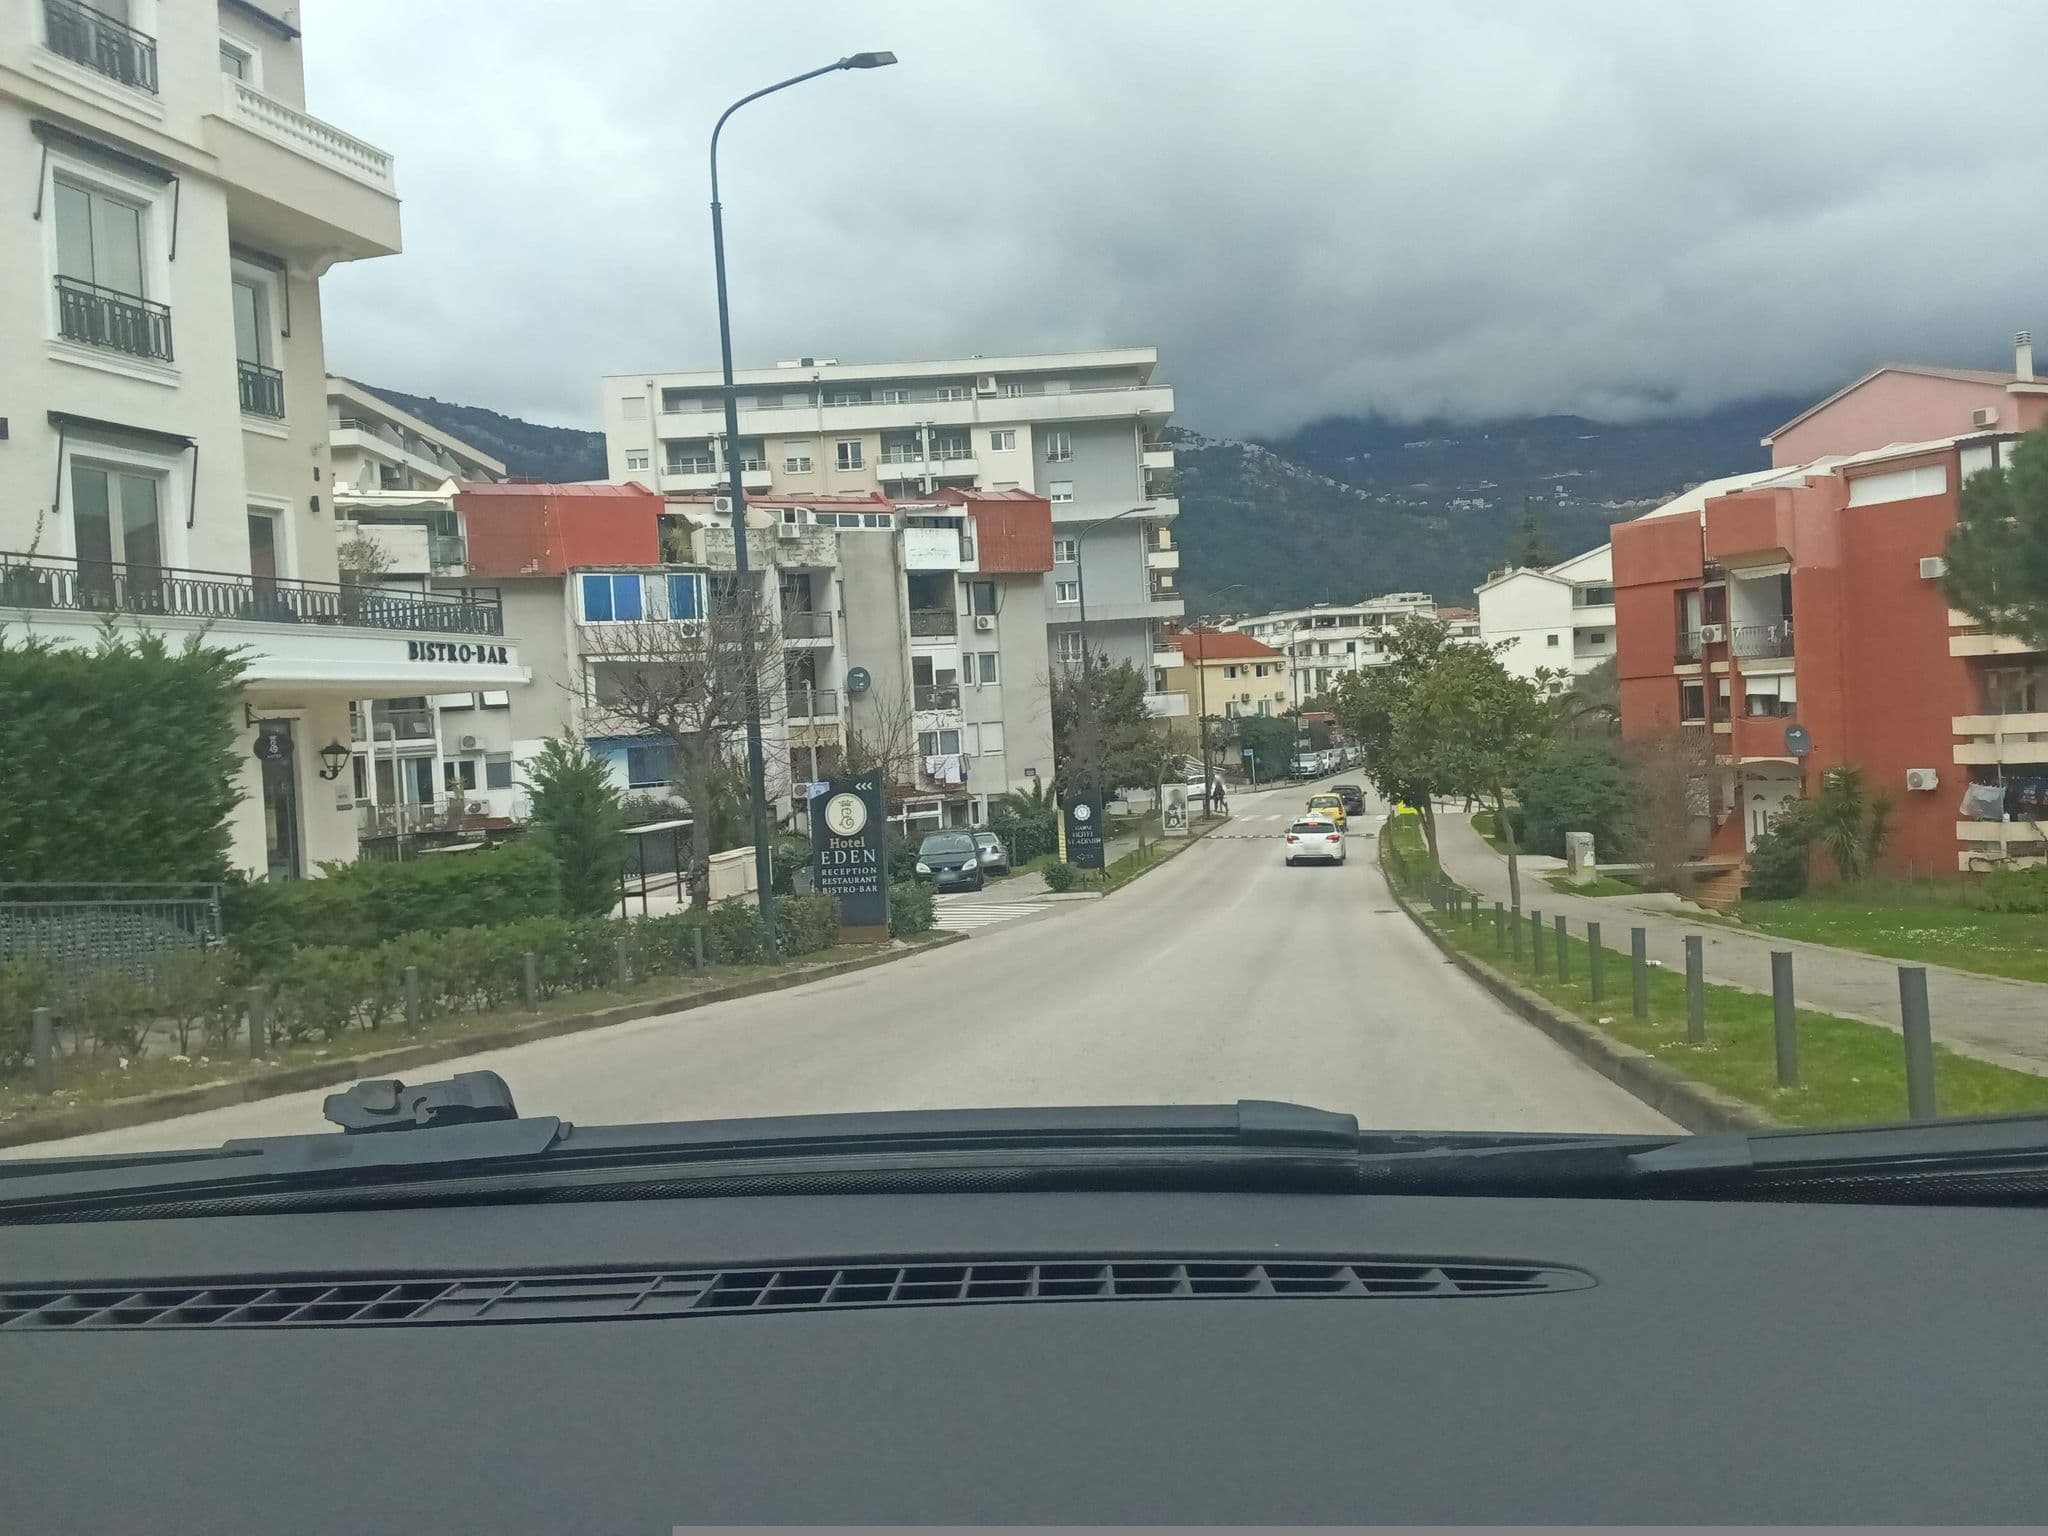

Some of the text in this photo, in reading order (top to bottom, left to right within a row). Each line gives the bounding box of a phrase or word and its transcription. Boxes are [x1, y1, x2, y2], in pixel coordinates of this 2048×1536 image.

[408, 640, 508, 664] BISTRO-BAR
[829, 836, 865, 848] Hotel
[821, 849, 876, 865] EDEN
[821, 866, 877, 876] RECEPTION
[822, 875, 878, 885] RESTAURANT
